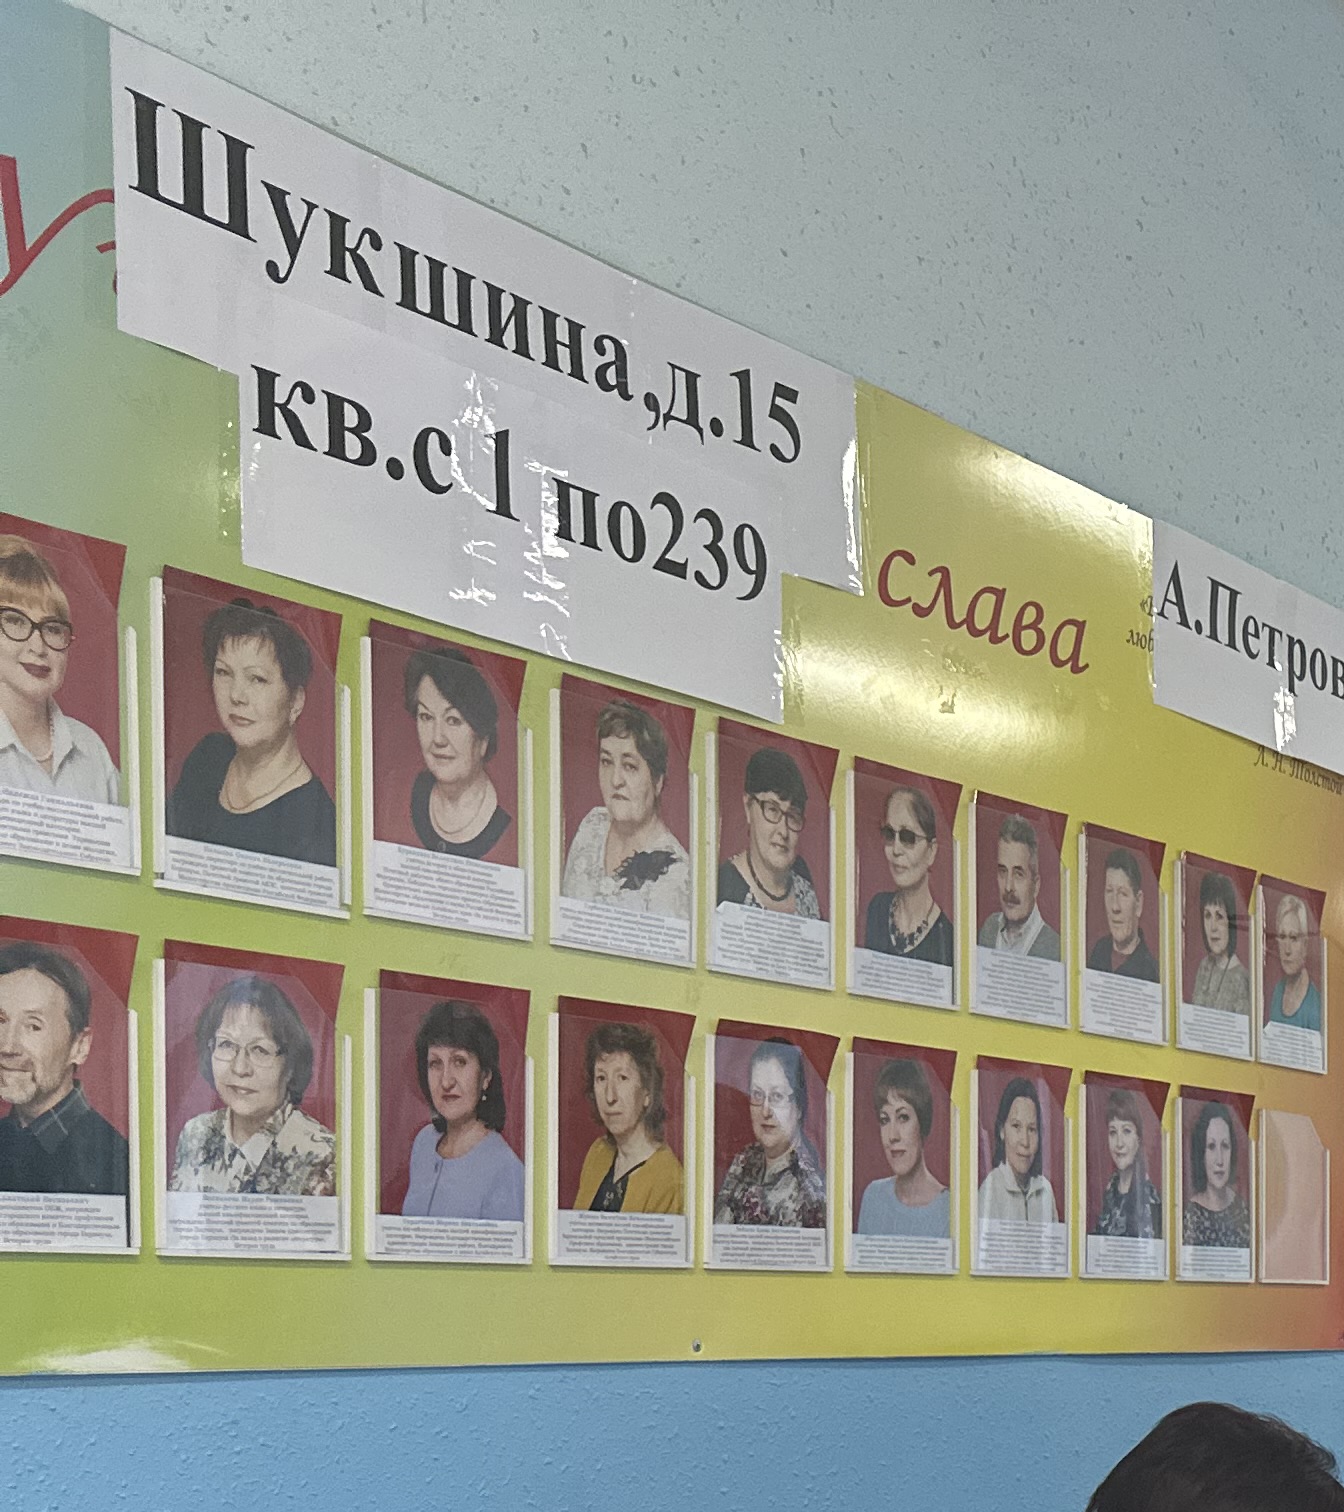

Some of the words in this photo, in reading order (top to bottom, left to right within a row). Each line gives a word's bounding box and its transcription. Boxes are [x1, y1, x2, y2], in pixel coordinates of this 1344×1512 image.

[125, 85, 803, 465] Шукшина,д.15
[250, 363, 455, 496] кв.с
[484, 426, 520, 523] 1
[551, 473, 769, 602] по239
[877, 549, 1091, 675] слава
